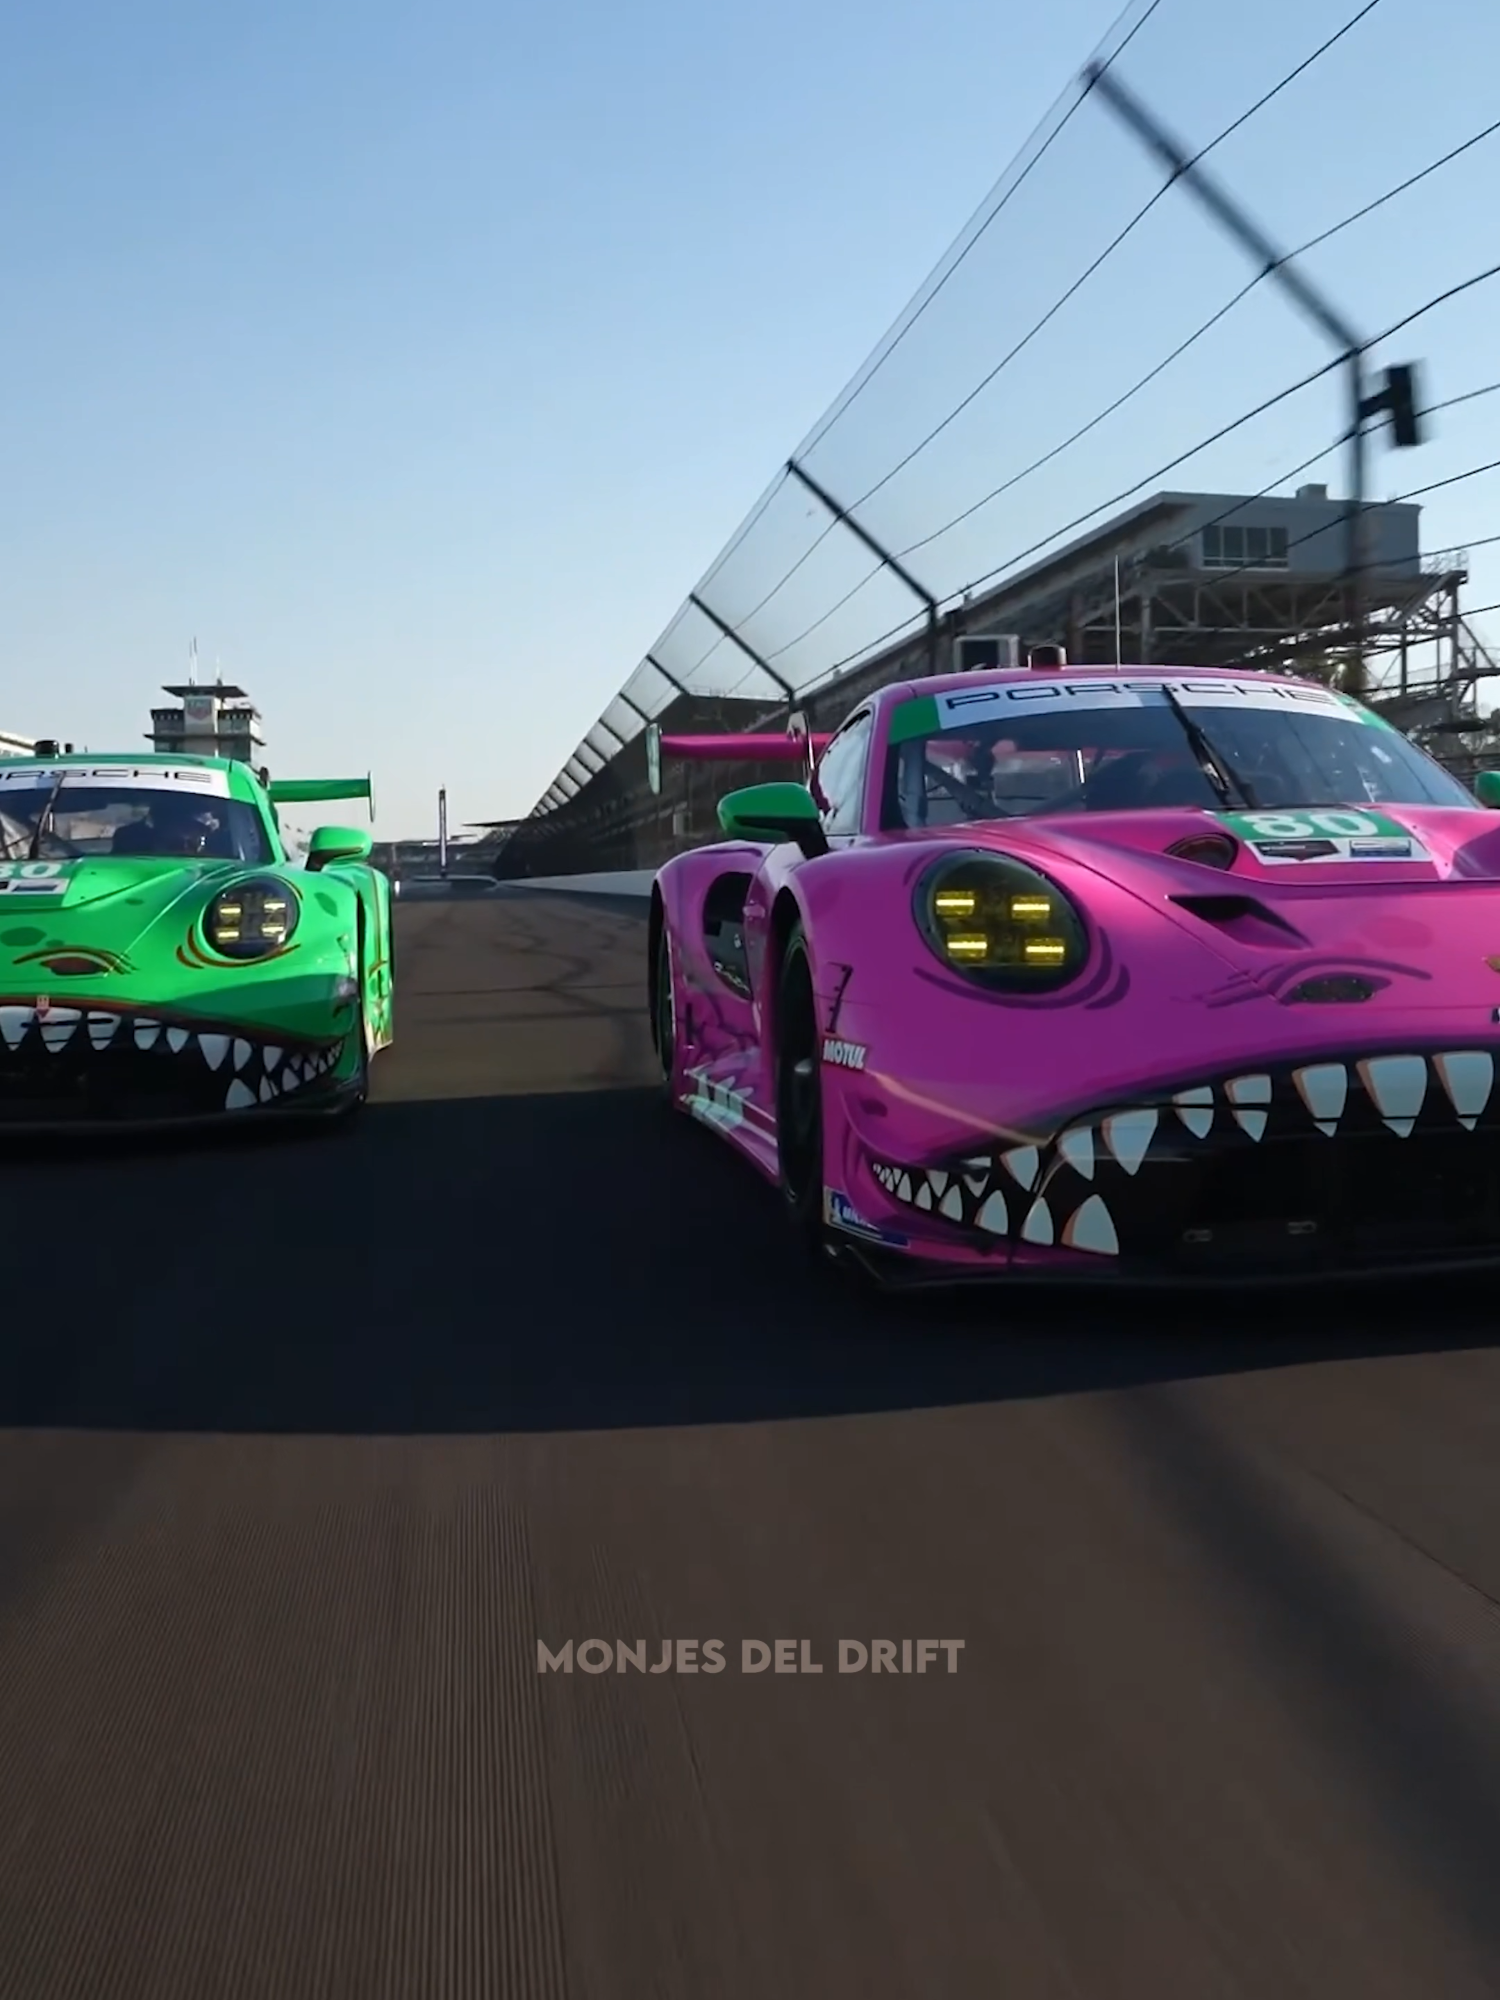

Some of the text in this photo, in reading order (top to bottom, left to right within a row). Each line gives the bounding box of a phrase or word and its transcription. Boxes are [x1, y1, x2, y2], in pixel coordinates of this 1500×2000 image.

[946, 683, 1337, 709] PORSCHE
[0, 769, 212, 783] RSCHE
[1242, 814, 1378, 837] 80
[823, 1039, 866, 1069] MOTUL
